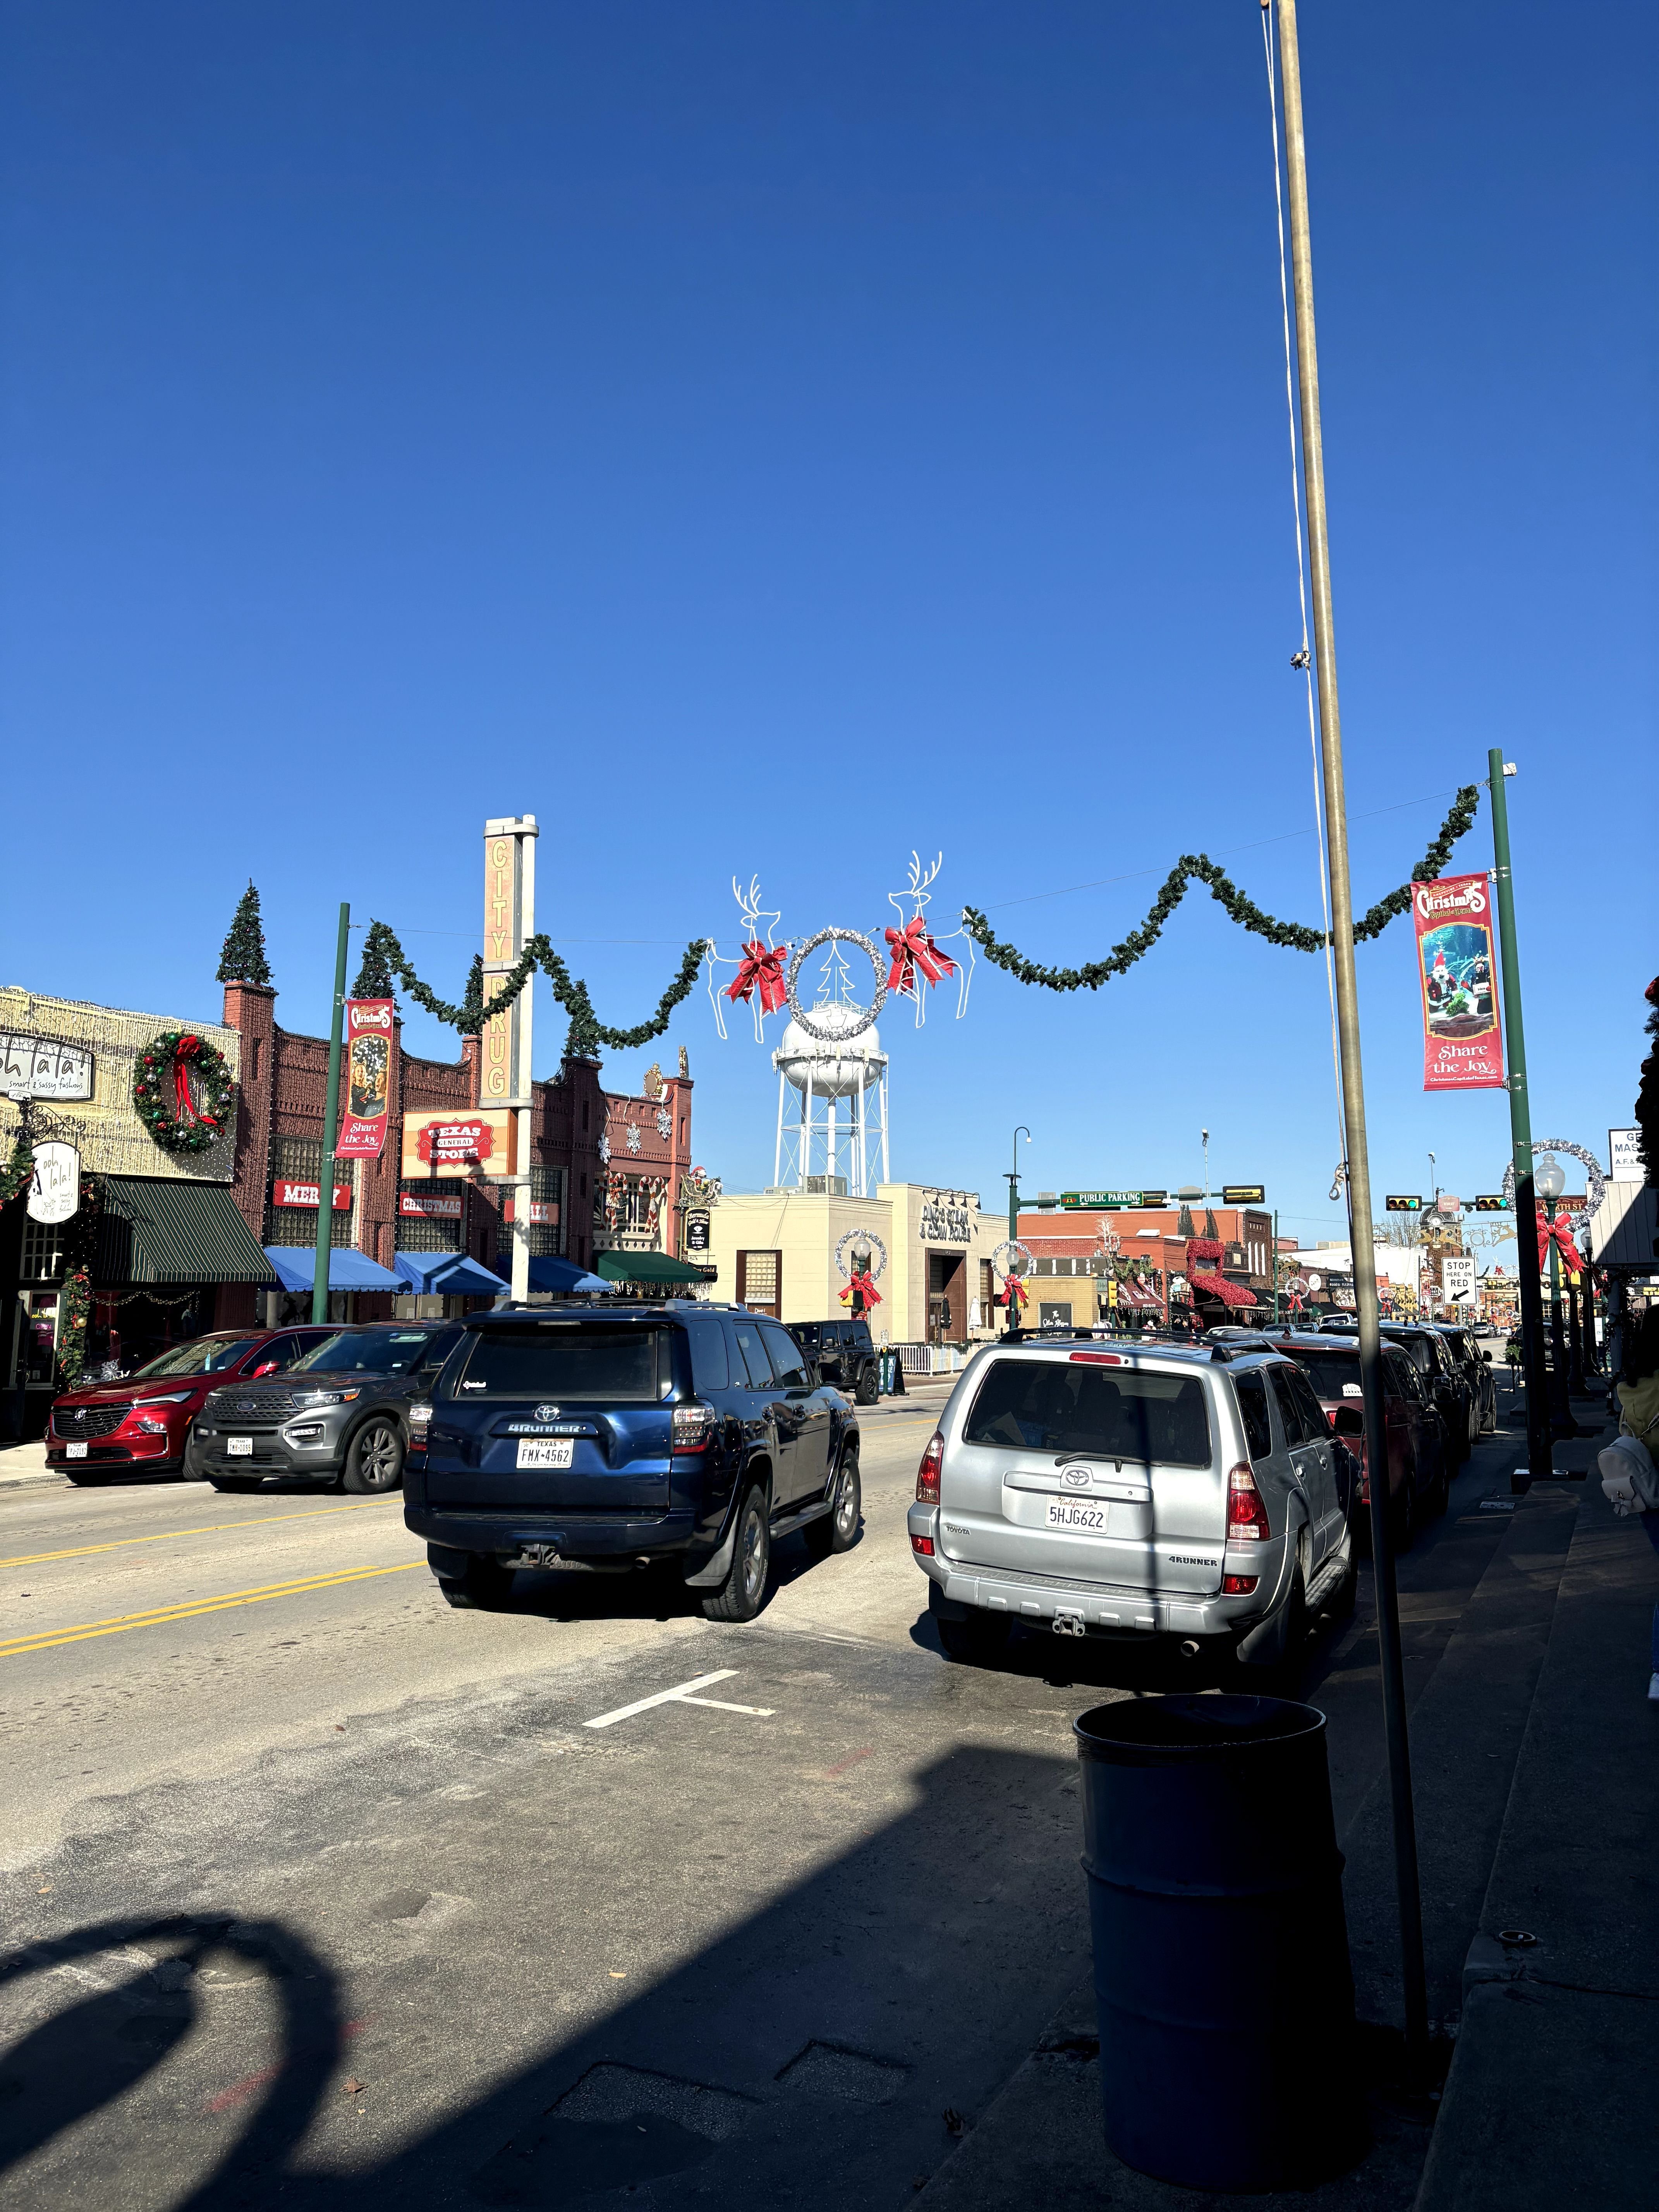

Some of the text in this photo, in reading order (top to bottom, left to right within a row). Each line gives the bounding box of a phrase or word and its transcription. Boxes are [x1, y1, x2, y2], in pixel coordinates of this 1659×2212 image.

[491, 840, 507, 958] CITY
[1438, 1045, 1488, 1060] Share
[1433, 1060, 1497, 1074] the Joy
[39, 1080, 56, 1094] sassy
[350, 1122, 379, 1133] Share
[428, 1126, 481, 1139] TEXAS
[345, 1134, 379, 1146] the Joy
[429, 1147, 479, 1159] STORE
[283, 1185, 340, 1206] MERY
[403, 1198, 461, 1213] CHRISTMAS
[1079, 1193, 1140, 1202] PUBLIC PARKING
[946, 1208, 968, 1225] STEAK
[927, 1223, 947, 1240] CLAW
[1060, 1498, 1097, 1509] California
[1050, 1506, 1103, 1528] 5HJG622
[946, 1526, 970, 1535] TOYOTA
[1169, 1556, 1218, 1566] 4RUNNER
